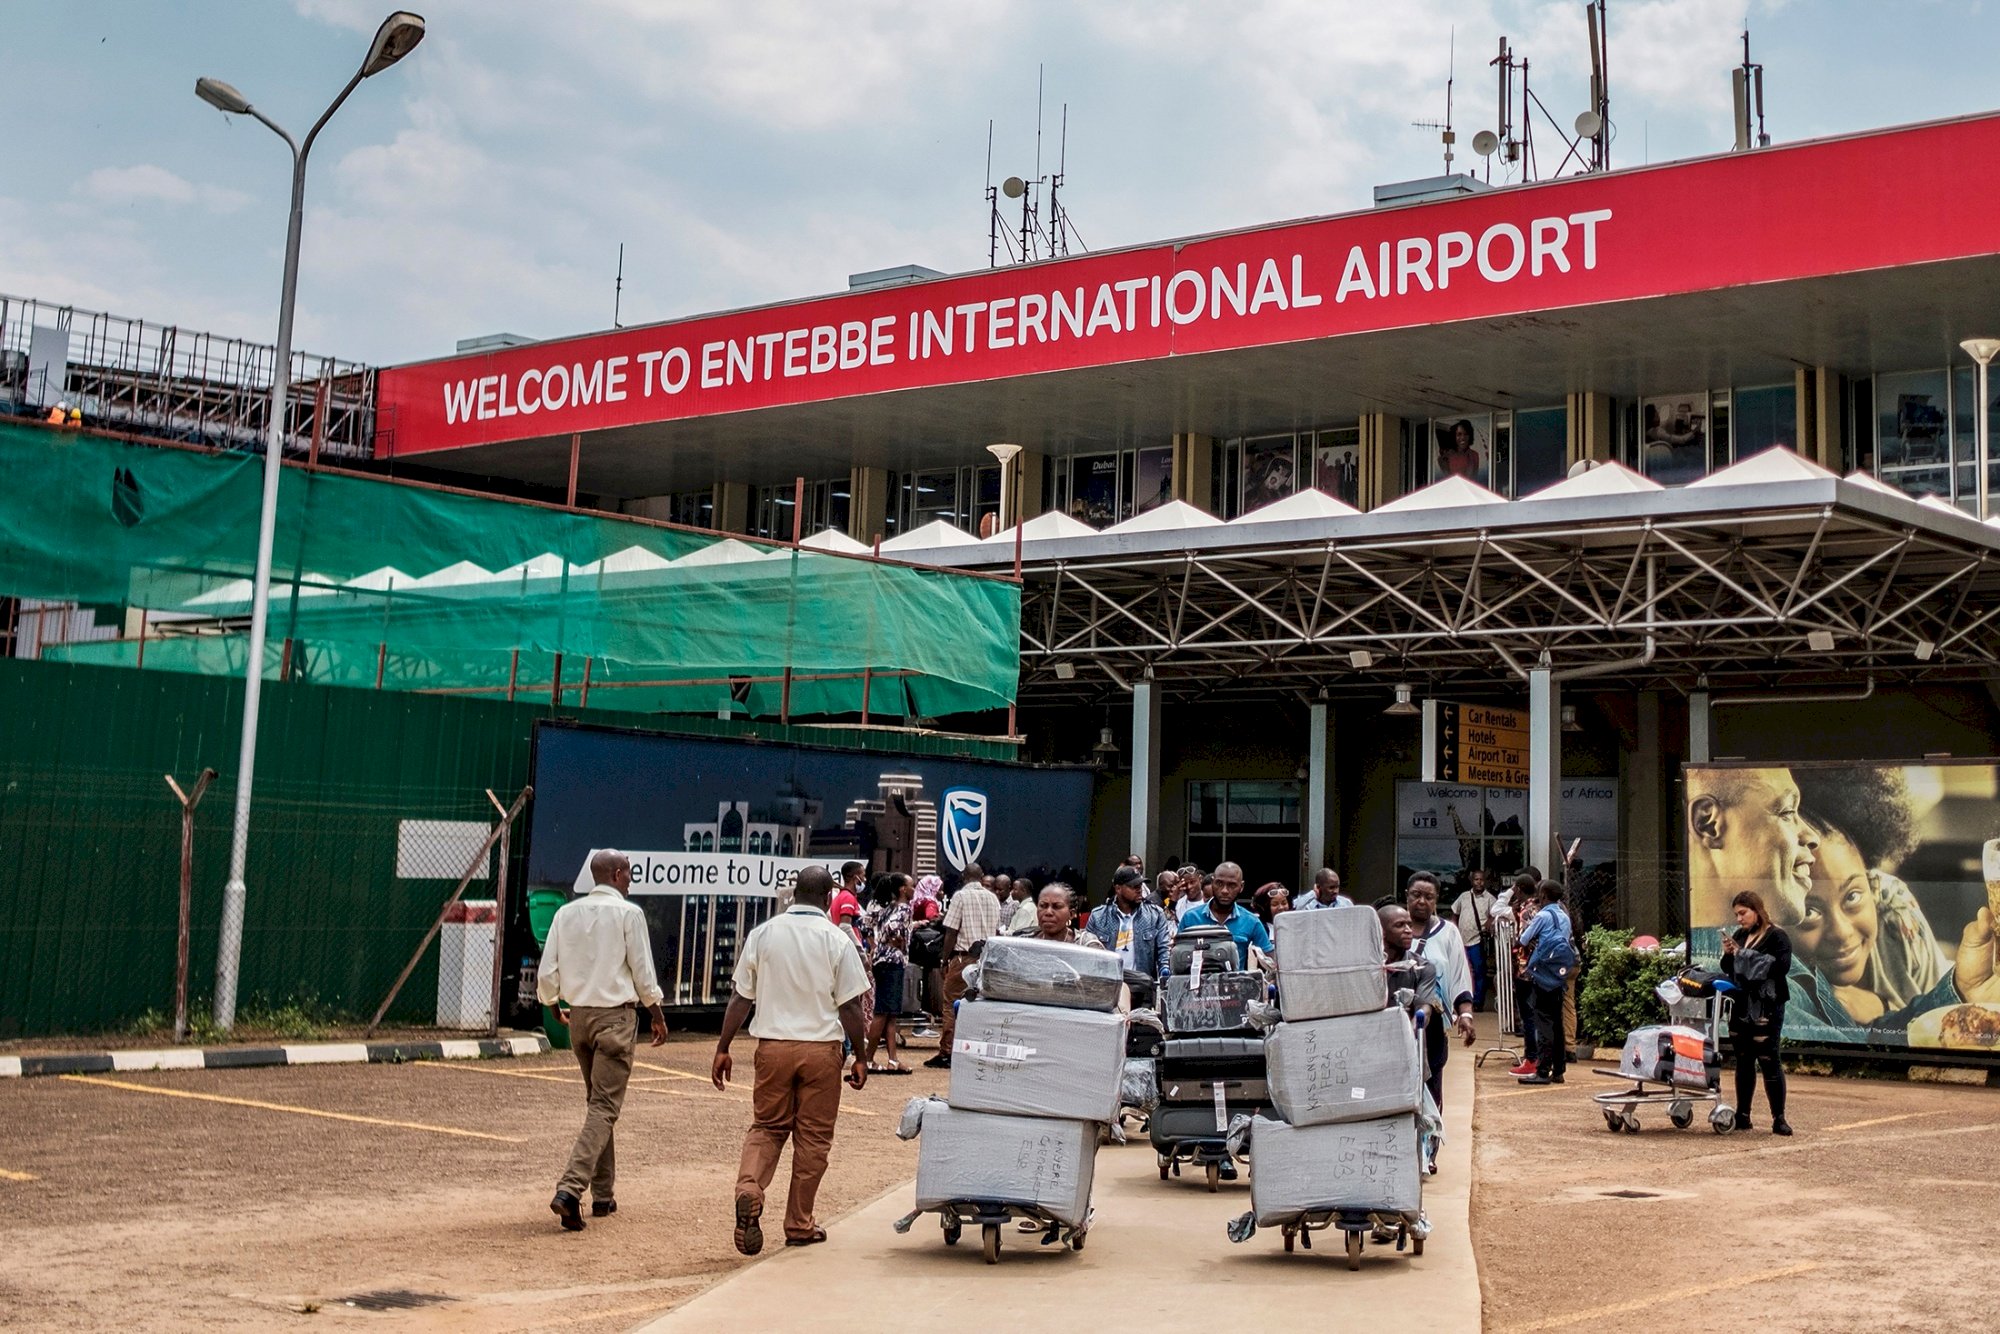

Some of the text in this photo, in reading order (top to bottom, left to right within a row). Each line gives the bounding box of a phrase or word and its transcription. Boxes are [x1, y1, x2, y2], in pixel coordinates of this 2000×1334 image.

[443, 208, 1613, 425] WELCOME TO ENTEBBE INTERNATIONAL AIRPORT
[1468, 708, 1517, 728] Car Rentals
[1468, 728, 1496, 745] Hotels
[1468, 746, 1519, 765] Airport Taxi
[1468, 765, 1503, 782] Meeters
[1505, 769, 1512, 783] &
[1427, 786, 1613, 799] Welcome to the of Africa
[1413, 817, 1438, 827] UTB
[629, 856, 842, 890] elcome to Ugaa
